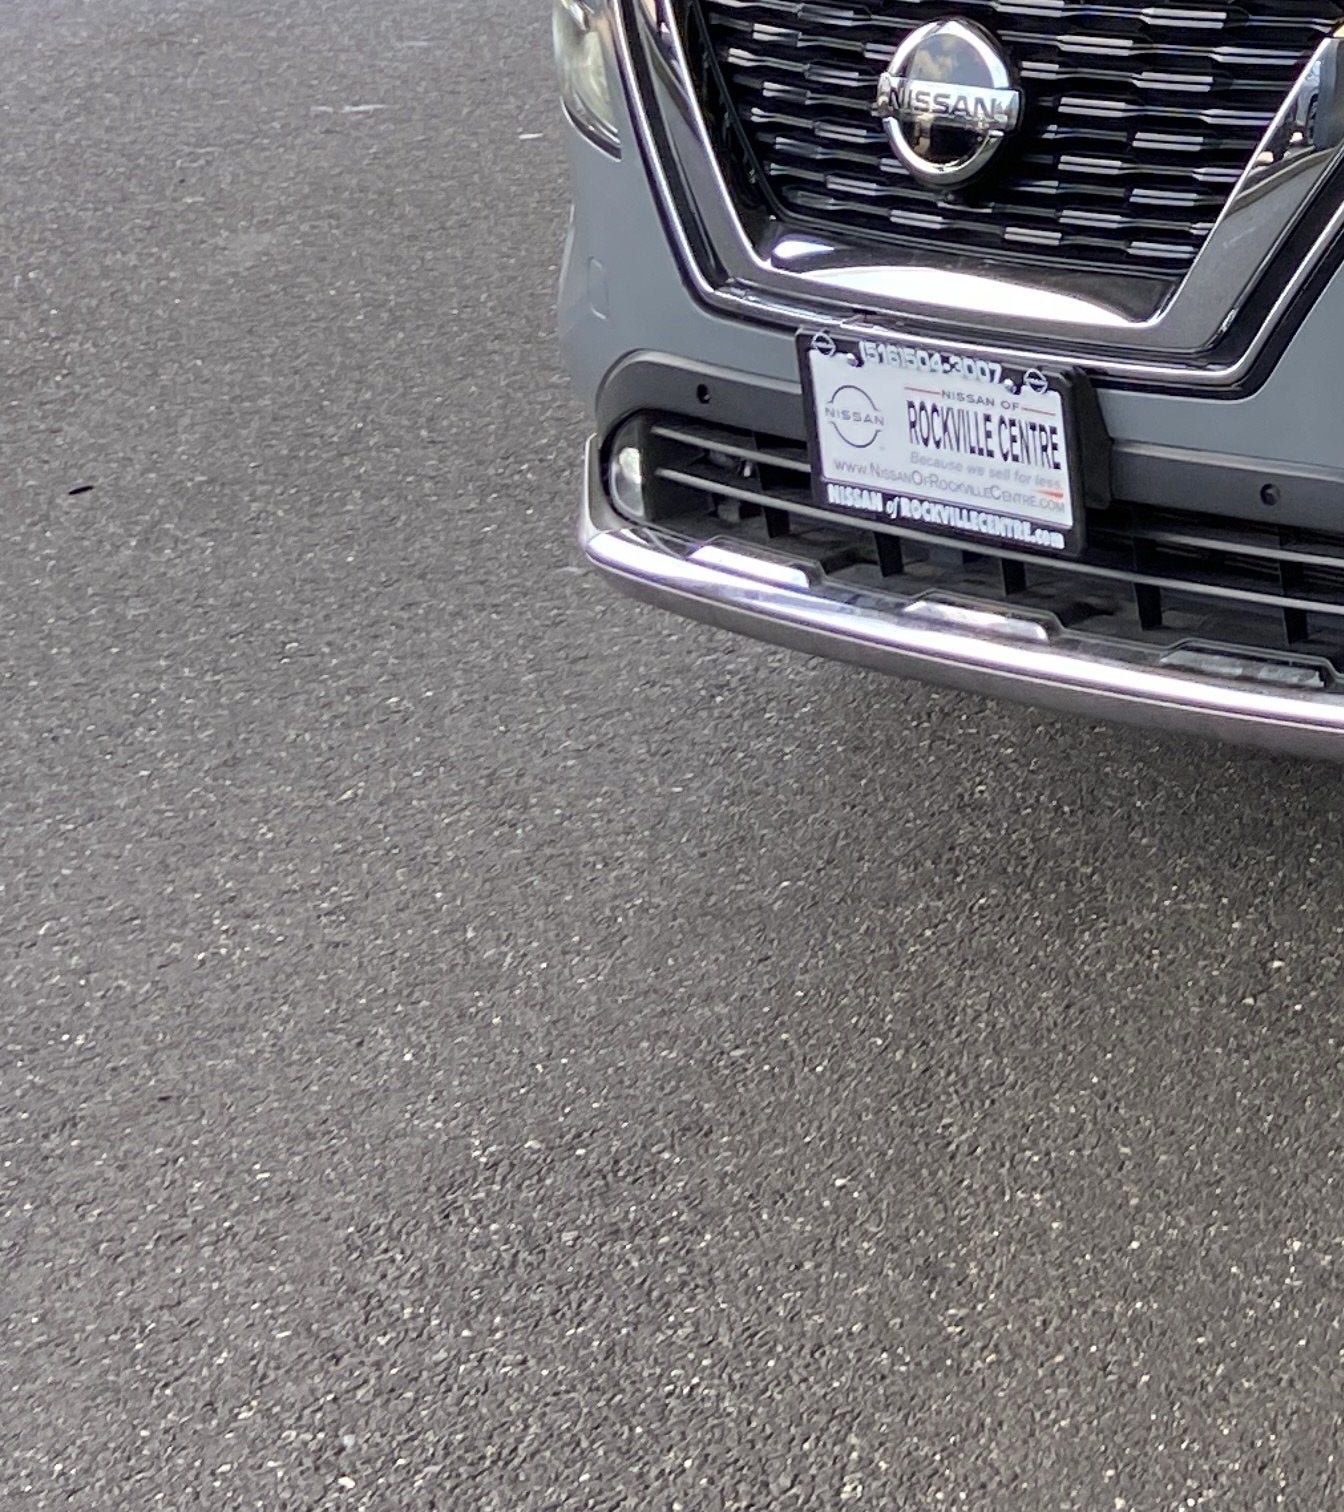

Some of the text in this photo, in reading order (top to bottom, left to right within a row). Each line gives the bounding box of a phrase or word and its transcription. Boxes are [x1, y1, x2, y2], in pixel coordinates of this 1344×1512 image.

[889, 84, 997, 119] NISSAN
[825, 407, 885, 426] NISSAN
[942, 390, 1020, 411] NISSAN OF
[906, 400, 1062, 470] ROCKVILLE CENTRE
[910, 451, 963, 471] Because
[967, 463, 986, 476] we
[988, 465, 1011, 480] sell
[1014, 469, 1032, 483] for
[827, 484, 883, 512] NISSAN
[886, 496, 900, 519] of
